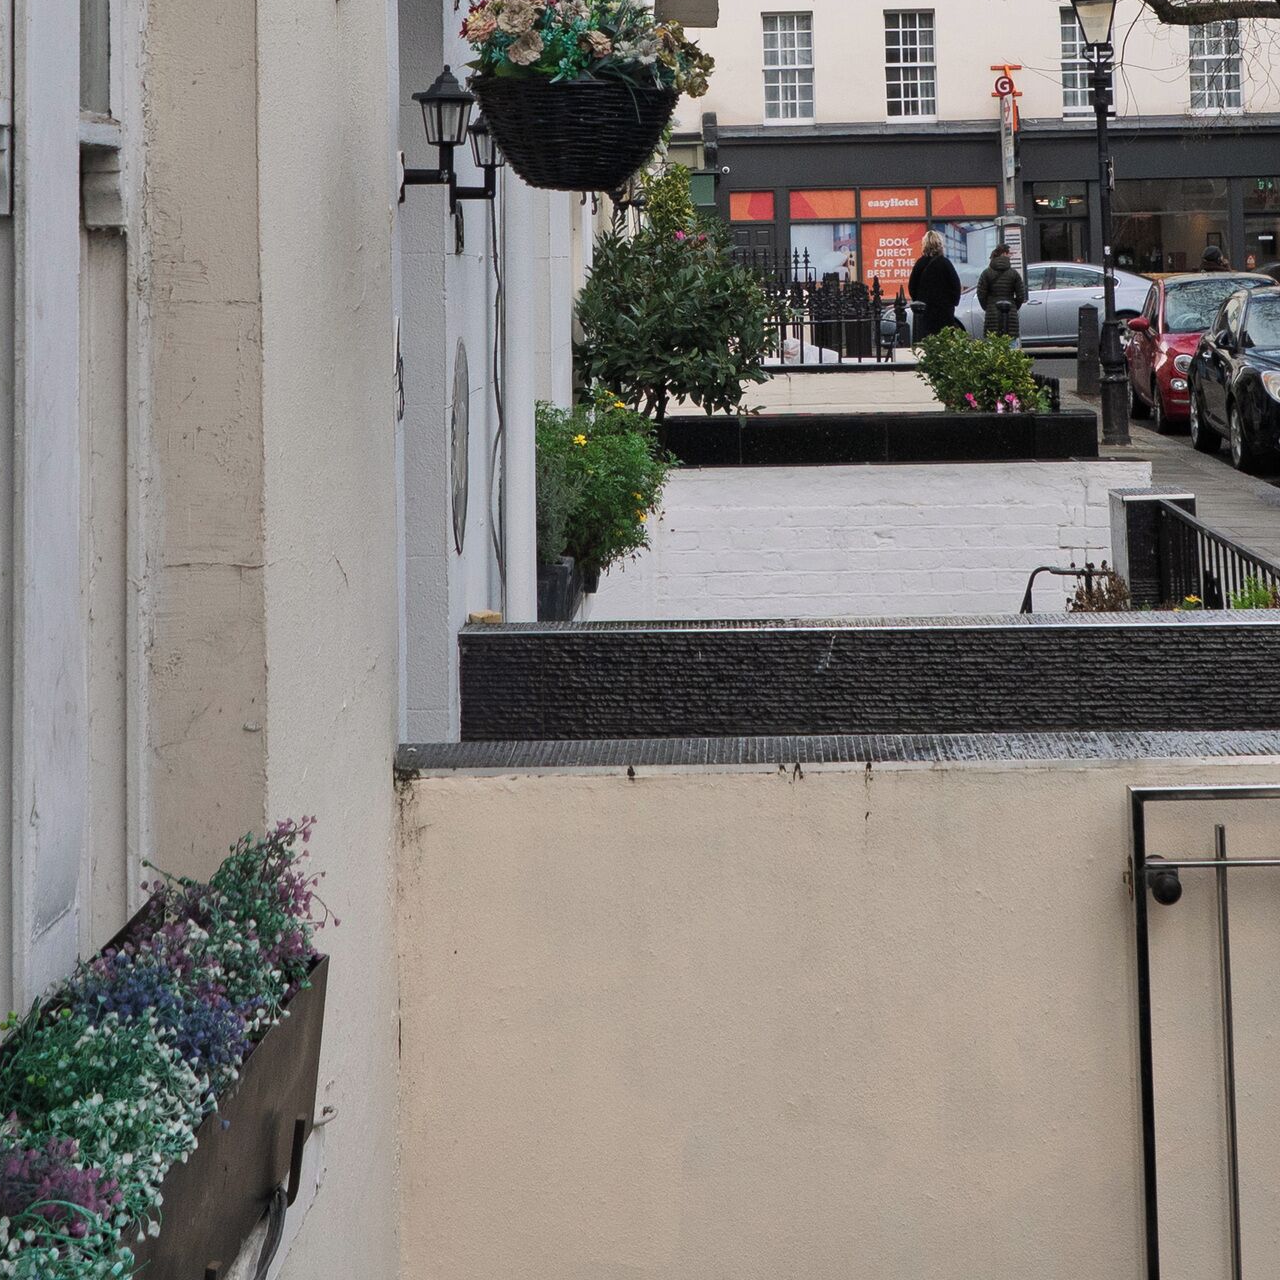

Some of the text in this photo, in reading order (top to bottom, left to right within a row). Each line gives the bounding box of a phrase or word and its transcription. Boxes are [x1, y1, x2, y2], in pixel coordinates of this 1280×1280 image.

[997, 79, 1010, 93] G
[867, 197, 919, 208] easyHotel
[879, 238, 910, 247] BOOK
[876, 248, 913, 257] DIRECT
[873, 258, 916, 267] FOR THE
[867, 269, 913, 278] BEST PRI
